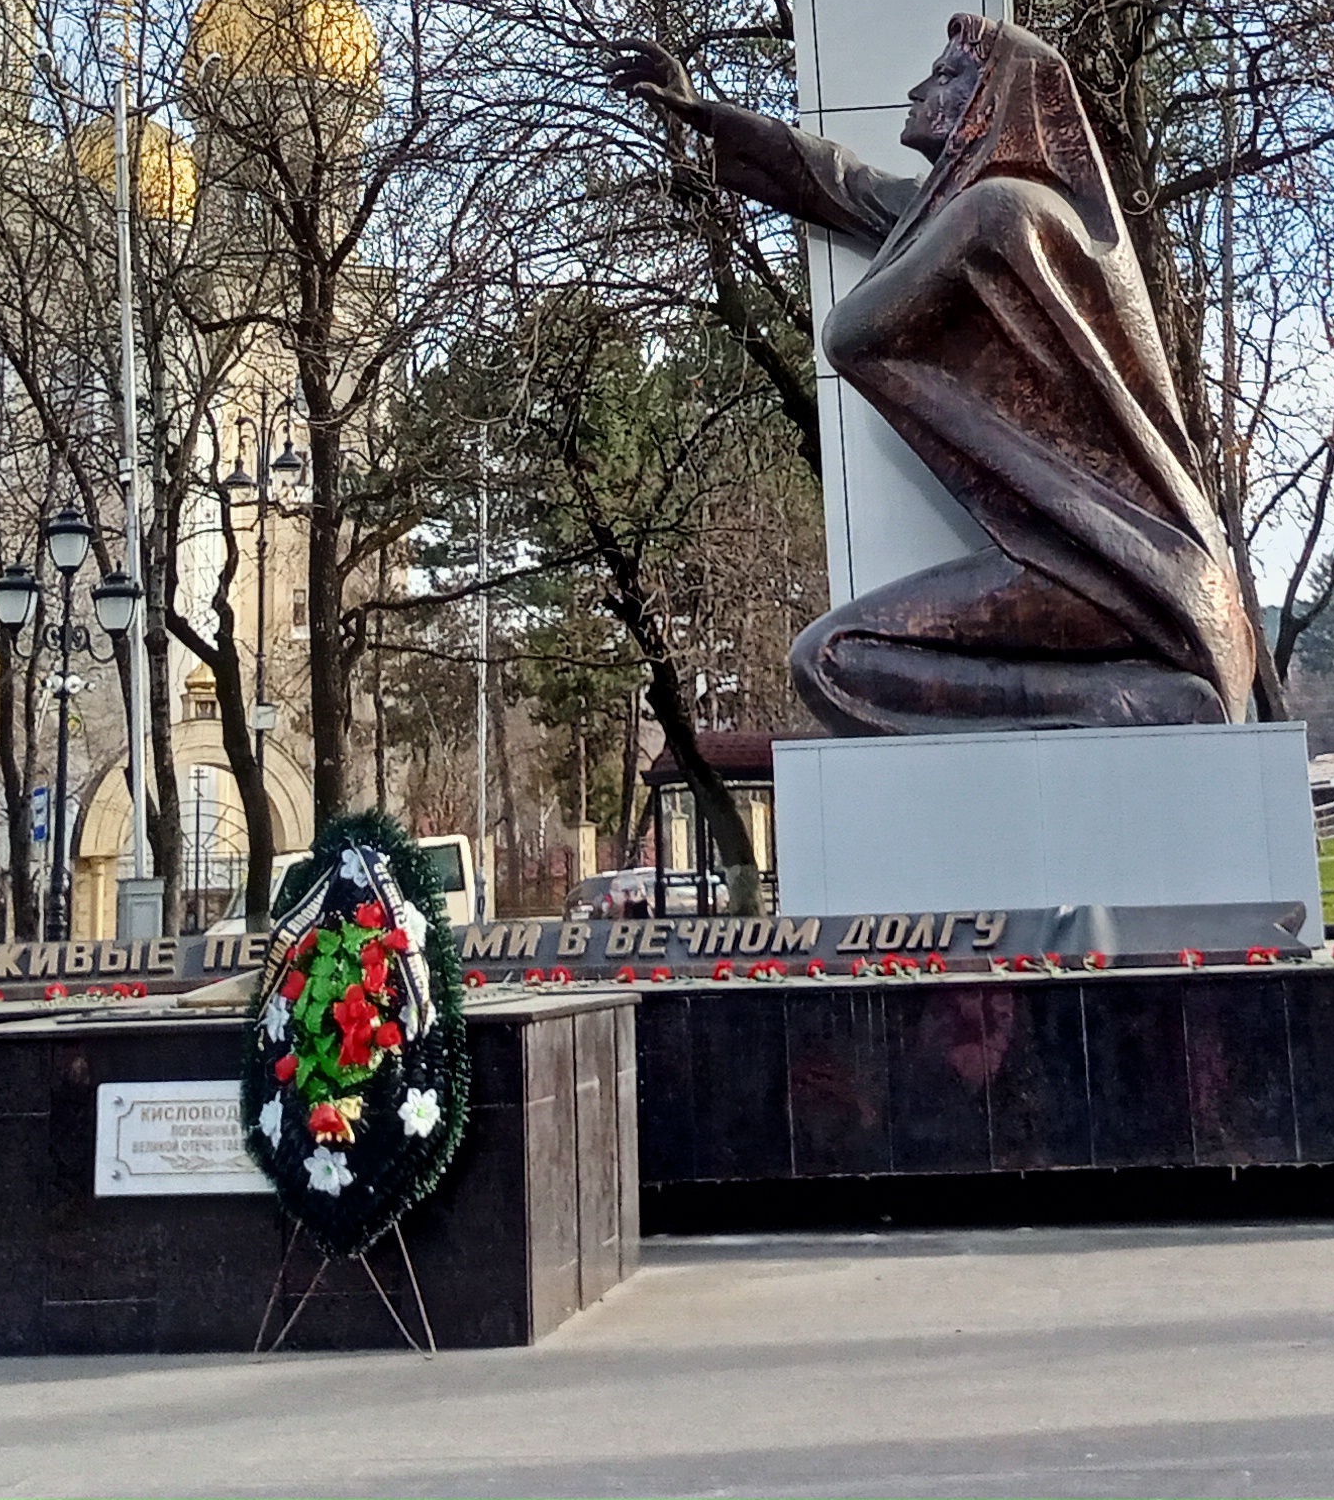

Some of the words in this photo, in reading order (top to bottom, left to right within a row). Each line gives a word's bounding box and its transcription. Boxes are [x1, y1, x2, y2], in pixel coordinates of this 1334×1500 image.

[462, 922, 543, 959] МИ
[557, 922, 592, 958] В
[605, 917, 822, 958] ВЕЧНОМ
[836, 911, 1008, 954] ДОЛГУ
[141, 1104, 240, 1123] КИСЛОВОД
